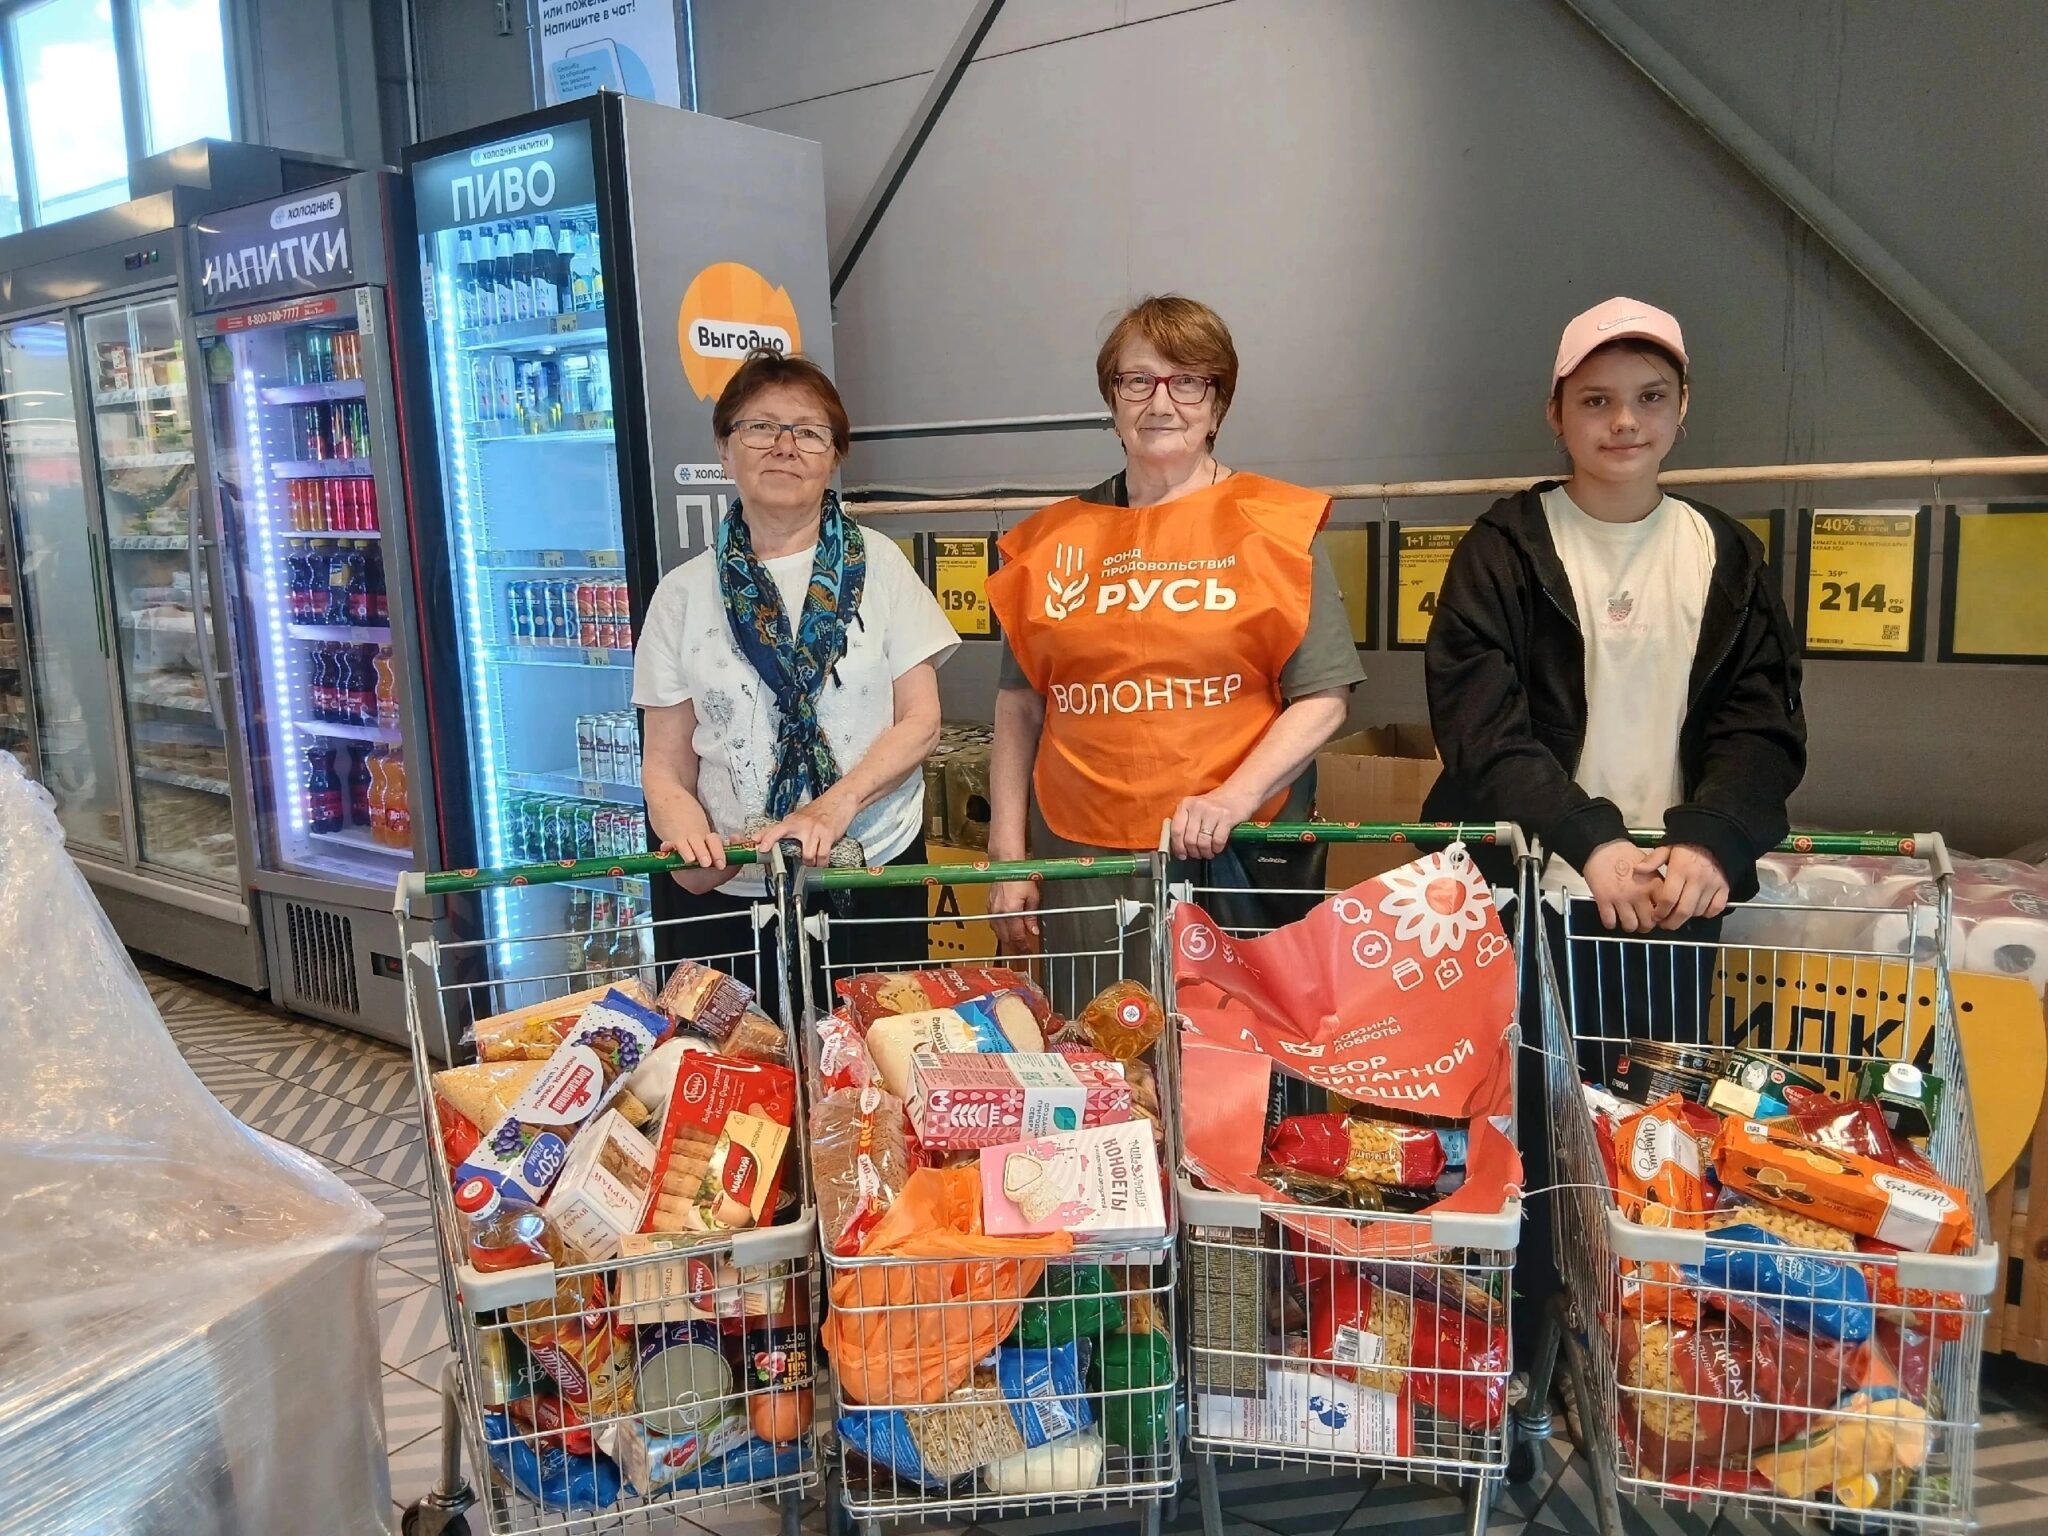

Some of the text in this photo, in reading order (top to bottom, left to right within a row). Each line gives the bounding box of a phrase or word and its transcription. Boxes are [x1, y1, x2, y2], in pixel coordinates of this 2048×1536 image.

[543, 6, 563, 20] или
[544, 0, 636, 37] Напишите в чат!
[483, 139, 550, 160] ХОЛОДНЫЕ НАПИТКИ
[451, 160, 556, 222] ПИВО
[287, 198, 334, 220] ХОЛОДНЫЕ
[204, 227, 349, 296] НАПИТКИ
[248, 306, 300, 326] 8-800-700-7777
[698, 326, 784, 351] Выгодно
[695, 468, 726, 481] ХОЛОД
[1816, 518, 1856, 532] -40%
[943, 543, 959, 556] 7%
[1406, 534, 1424, 547] 1+1
[1100, 555, 1236, 578] ПРОДОВОЛЬСТВИЯ
[1103, 548, 1142, 568] ФОНД
[942, 589, 977, 611] 139
[1095, 578, 1237, 614] РУСЬ
[1418, 591, 1438, 616] 4
[1819, 582, 1886, 613] 214
[1050, 674, 1242, 714] ВОЛОНТЕР
[1188, 927, 1208, 952] 5
[1333, 1016, 1398, 1045] КОРЗИНА
[1334, 1025, 1402, 1054] ДОБРОТЫ
[1709, 993, 1937, 1083] ИДКА
[1308, 1056, 1388, 1074] СБОР
[1309, 1038, 1475, 1086] НИТАРНОЙ
[1339, 1083, 1440, 1101] МОЩИ
[1042, 1102, 1050, 1136] СОЗДАНО
[526, 1140, 544, 1166] ИЗЮМА
[534, 1143, 562, 1186] +30%
[730, 1156, 750, 1193] МАЙСКИЙ
[1102, 1138, 1128, 1211] КОНФЕТЫ
